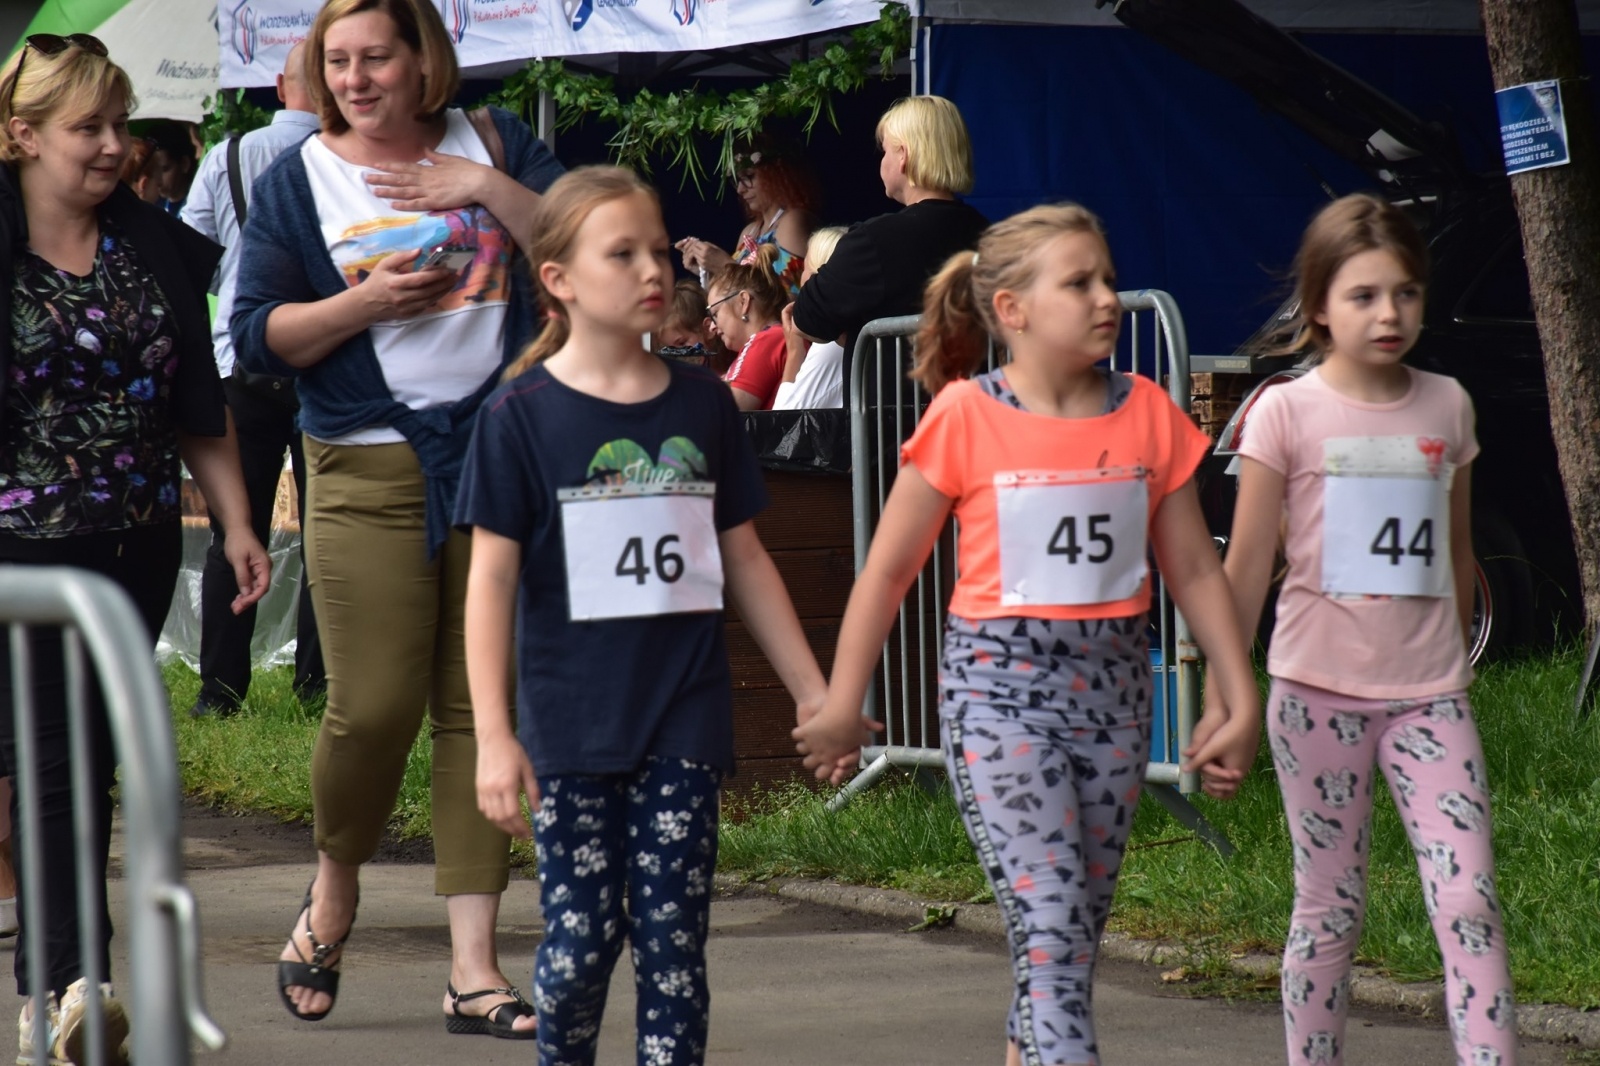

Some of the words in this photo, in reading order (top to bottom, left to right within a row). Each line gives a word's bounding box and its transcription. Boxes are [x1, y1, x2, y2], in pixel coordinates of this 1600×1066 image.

[1540, 150, 1555, 159] BEZ
[615, 533, 685, 585] 46
[1046, 513, 1114, 565] 45
[1370, 517, 1435, 567] 44
